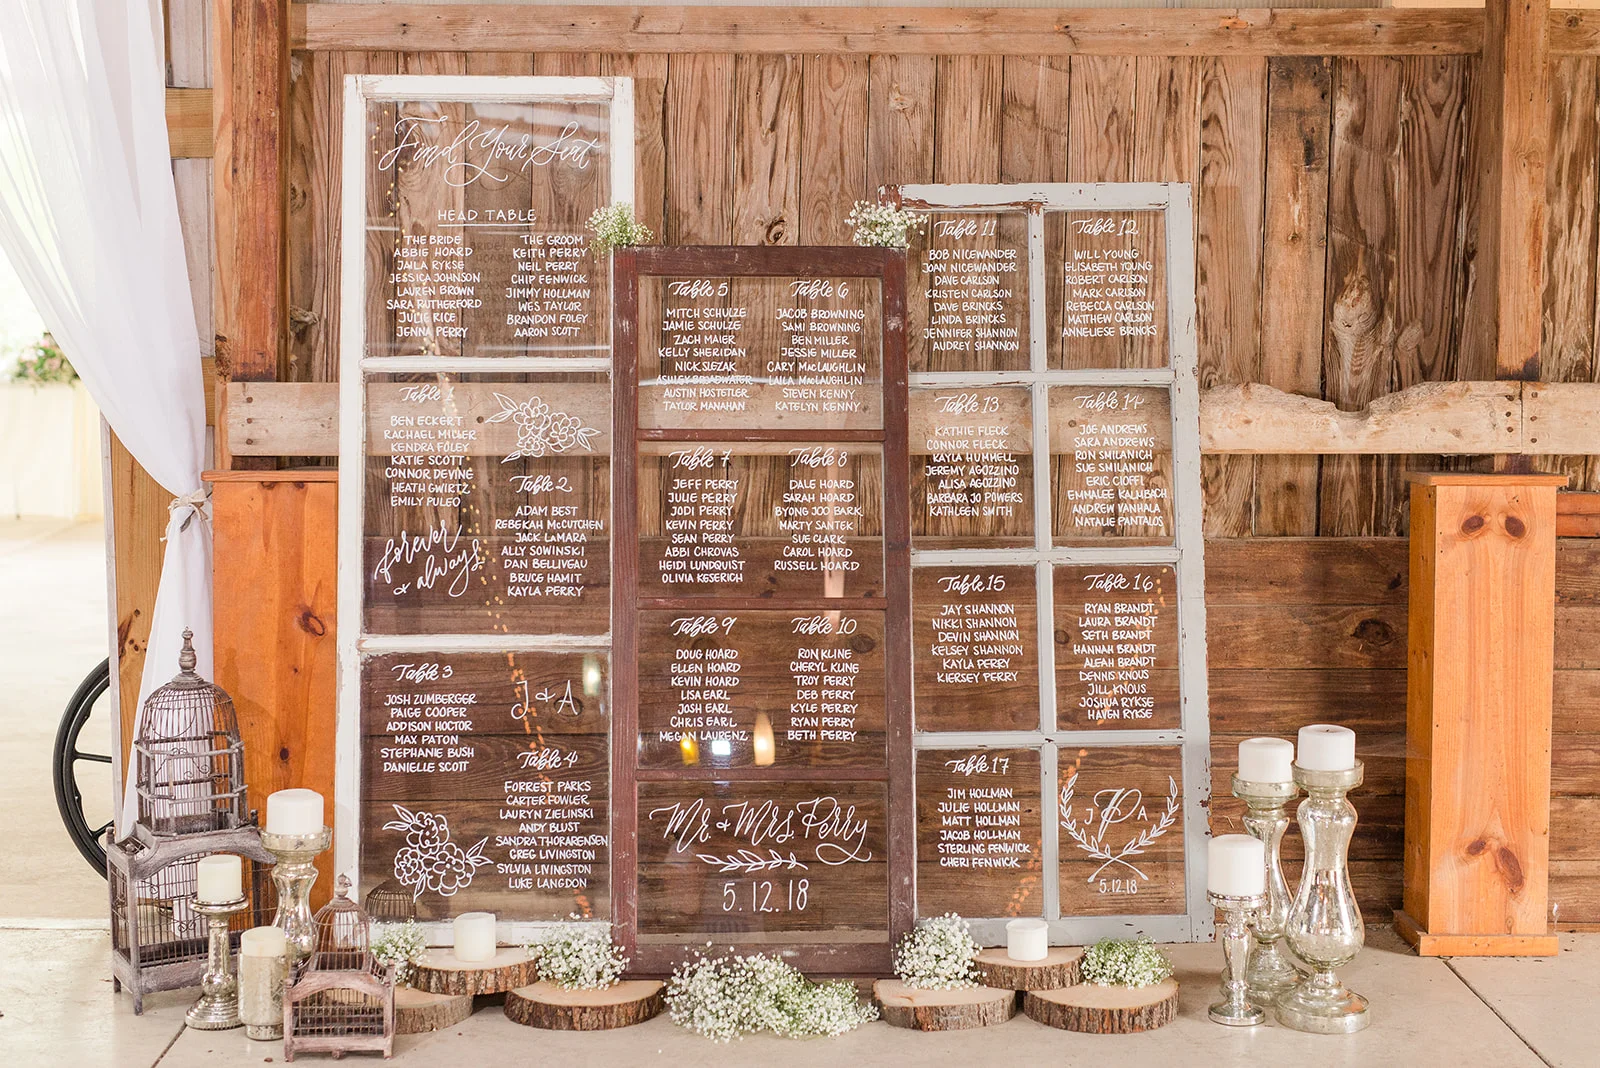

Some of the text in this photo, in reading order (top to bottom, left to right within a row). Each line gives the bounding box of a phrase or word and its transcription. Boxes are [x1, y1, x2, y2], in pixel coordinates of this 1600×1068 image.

[379, 116, 602, 187] Find Your Seat
[438, 210, 536, 221] HEAD TABLE
[934, 219, 997, 239] Table 11
[1072, 218, 1139, 236] Table 12
[404, 236, 461, 245] THE BRIDE
[521, 235, 583, 245] THE GROOM
[929, 249, 1016, 260] BOB NICEWANDER
[1065, 261, 1152, 272] ELISABETH YOUNG
[389, 273, 480, 283] JESSICA JOHNSON
[512, 275, 587, 284] CHIP FENWICK
[398, 286, 474, 296] LAUREN BROWN
[506, 289, 590, 298] JIMMY HOLLMAN
[668, 280, 728, 297] Table 5
[790, 279, 848, 298] Table 6
[925, 288, 1012, 299] KRISTEN CARLSON
[387, 299, 482, 309] SARA RUTHERFORD
[1066, 301, 1154, 311] REBECCA CARLSON
[666, 308, 746, 318] MITCH SCHULZE
[776, 309, 864, 319] JACOB BROWNING
[507, 314, 588, 324] BRANDON FOLEY
[658, 348, 745, 357] KELLY SHERIDAN
[781, 348, 856, 358] JESSIE MILLER
[399, 384, 440, 403] Table
[935, 394, 999, 415] Table 13
[1073, 391, 1144, 412] Table 14
[385, 430, 476, 440] RACHAEL MILLER
[1075, 437, 1154, 447] SARA ANDREWS
[392, 456, 464, 465] KATIE SCOTT
[669, 446, 732, 470] Table 7
[788, 447, 847, 467] Table 8
[386, 469, 473, 479] CONNOR DEVINE
[925, 465, 1019, 476] JEREMY AGOZZINO
[510, 475, 572, 494] Table 2
[790, 479, 854, 489] DALE HOARD
[1068, 489, 1167, 500] EMMALEE KALMBACH
[516, 506, 578, 516] ADAM BEST
[671, 506, 733, 517] JODI PERRY
[930, 506, 1012, 516] KATHLEEN SMITH
[1073, 504, 1160, 514] ANDREW VANHALA
[495, 520, 603, 529] REBEKAH McCUTCHEN
[780, 520, 853, 530] MARTY SANTEK
[374, 520, 462, 584] forever
[417, 539, 484, 597] always
[659, 560, 745, 570] HEIDI LUNDQUIST
[775, 561, 859, 571] RUSSELL HOARD
[938, 574, 1005, 594] Table 15
[1084, 573, 1153, 592] Table 16
[671, 616, 737, 637] Table 9
[791, 617, 857, 635] Table 10
[932, 617, 1016, 629] NIKKI SHANNON
[676, 649, 738, 660] DOUG HOARD
[932, 645, 1023, 655] KELSEY SHANNON
[1073, 644, 1156, 654] HANNAH BRANDT
[391, 663, 453, 683] Table 3
[671, 676, 739, 687] KEVIN HOARD
[794, 675, 855, 687] TROY PERRY
[384, 694, 477, 705] JOSH ZUMBERGER
[1079, 697, 1154, 707] JOSHUA RYKSE
[386, 721, 473, 731] ADDISON HOCTOR
[791, 717, 855, 727] RYAN PERRY
[788, 731, 857, 741] BETH PERRY
[381, 747, 474, 758] STEPHANIE BUSH
[517, 749, 577, 770] Table 4
[945, 755, 1009, 776] Table 17
[505, 781, 591, 792] FORREST PARKS
[937, 802, 1020, 812] JULIE HOLLMAN
[500, 809, 594, 819] LAURYN ZIELINSKI
[797, 797, 872, 865] Perry
[940, 830, 1020, 841] JACOB HOLLMAN
[496, 836, 608, 846] SANDRA THORARENSEN
